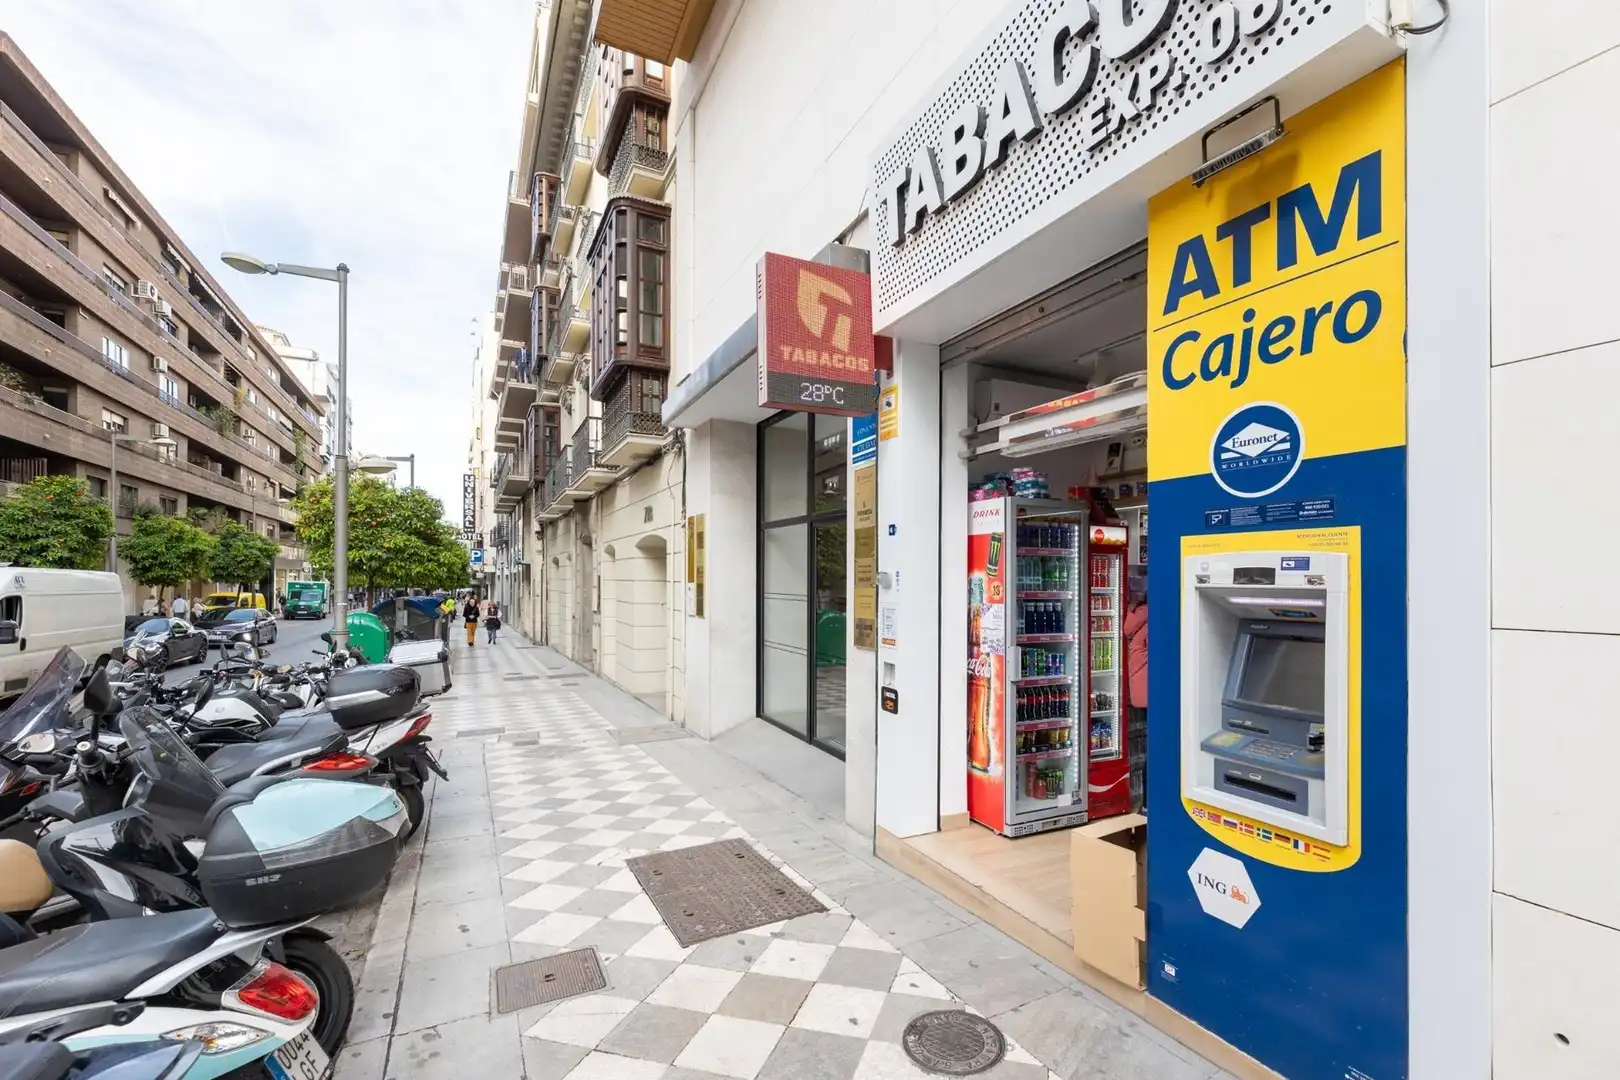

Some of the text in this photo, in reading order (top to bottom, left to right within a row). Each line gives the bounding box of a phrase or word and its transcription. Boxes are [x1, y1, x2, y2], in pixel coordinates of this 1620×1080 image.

[1163, 149, 1382, 316] ATM
[1163, 289, 1382, 391] Cajero
[780, 345, 869, 372] TABACOS
[1231, 432, 1278, 448] Euronet
[1221, 454, 1292, 469] WORLDWIDE
[464, 475, 474, 527] UNIVERSAL
[973, 509, 1001, 518] DRINK
[471, 551, 481, 562] P
[1197, 873, 1228, 895] ING
[291, 1050, 320, 1080] GF
